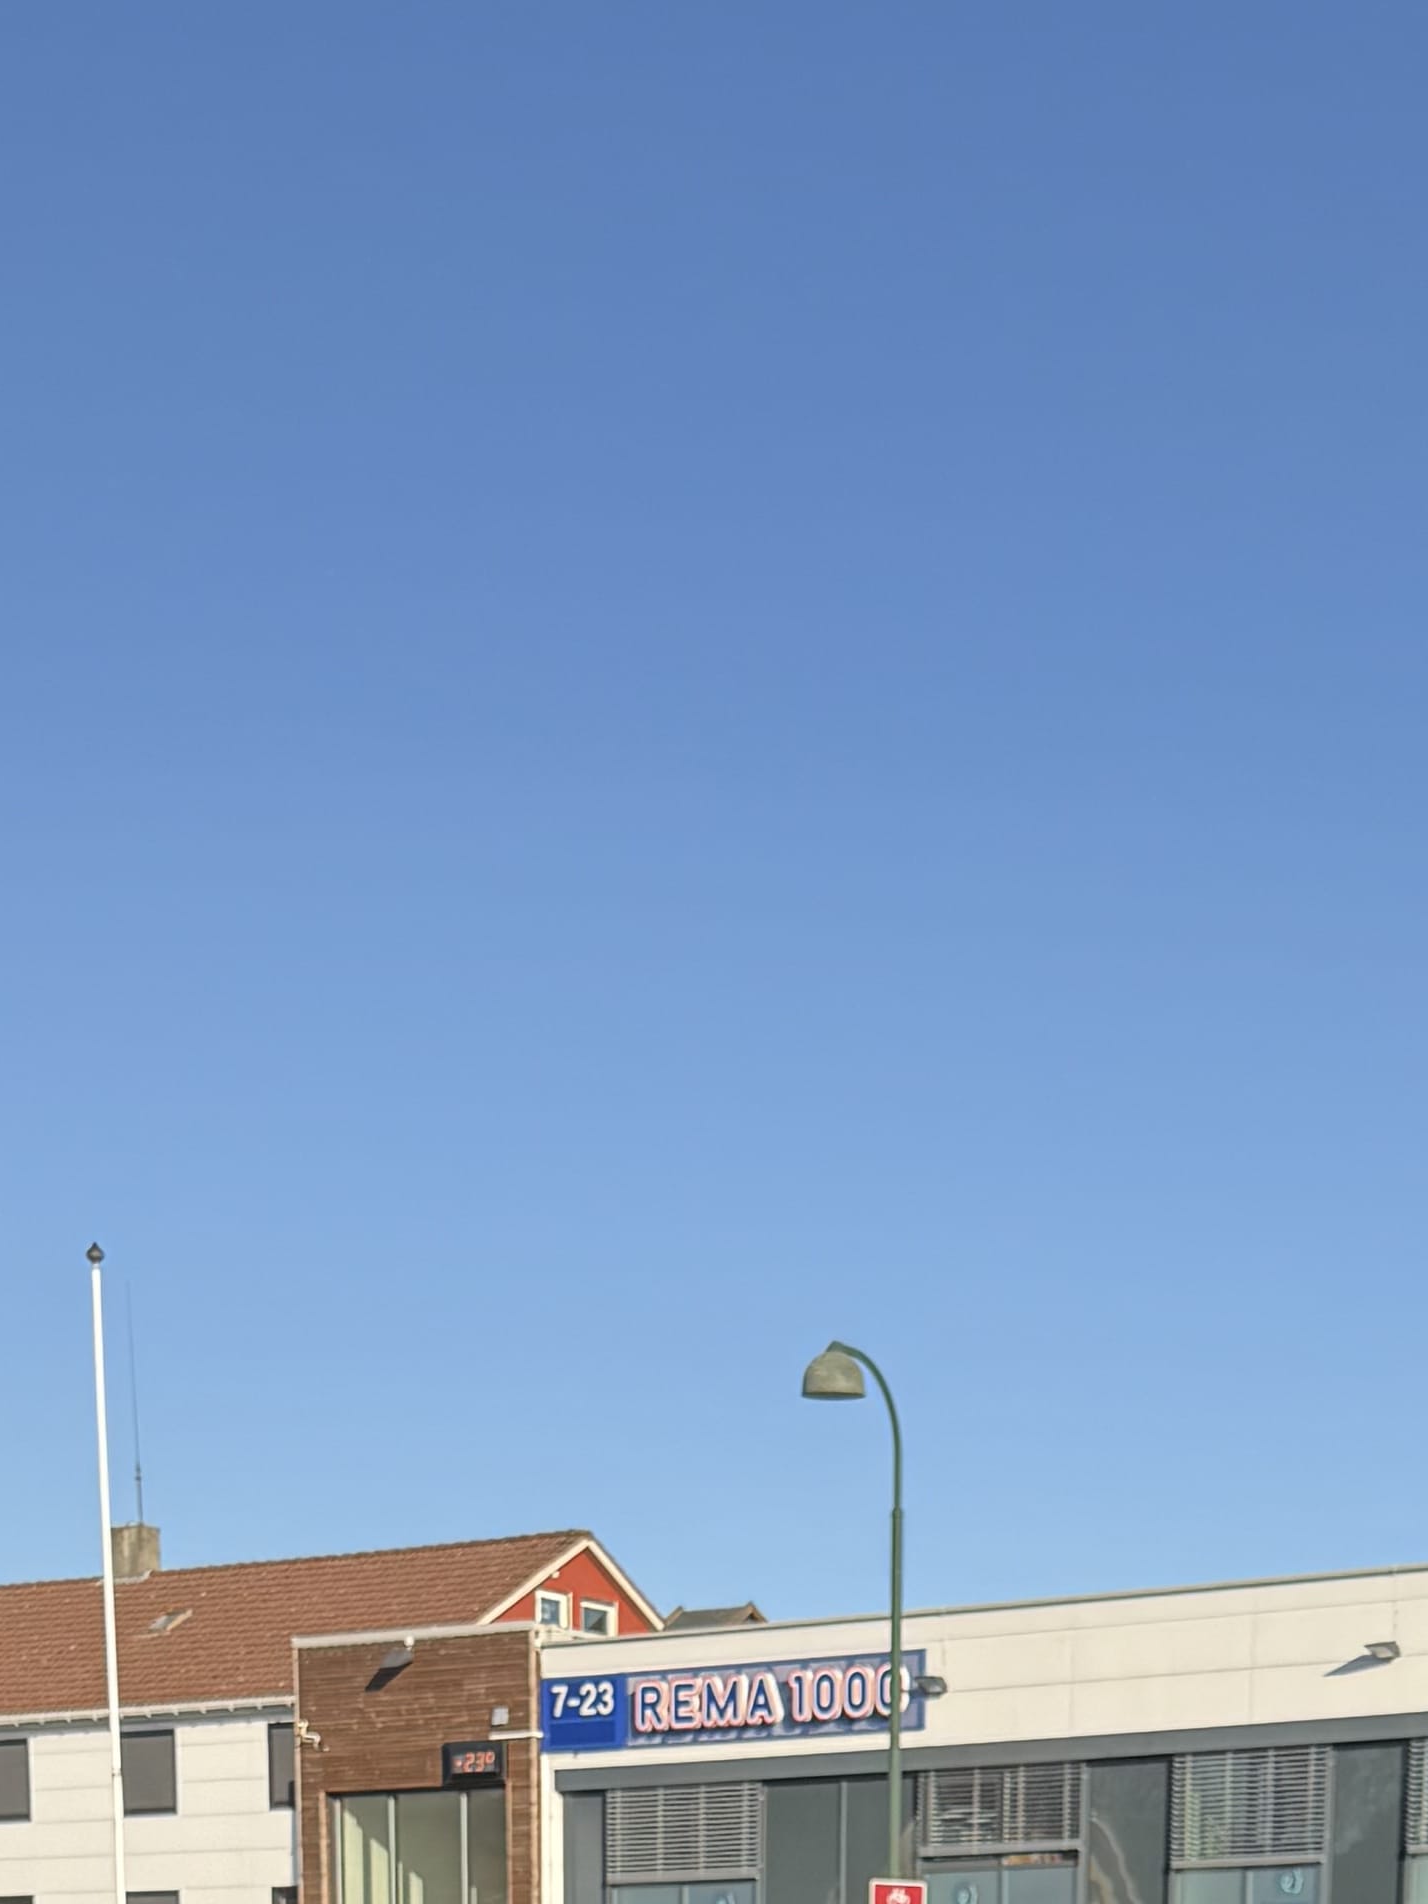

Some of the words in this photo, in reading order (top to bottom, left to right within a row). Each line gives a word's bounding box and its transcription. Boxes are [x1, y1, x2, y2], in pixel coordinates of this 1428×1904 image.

[550, 1681, 614, 1718] 7-23
[634, 1672, 782, 1733] REMA
[789, 1663, 910, 1723] 1000
